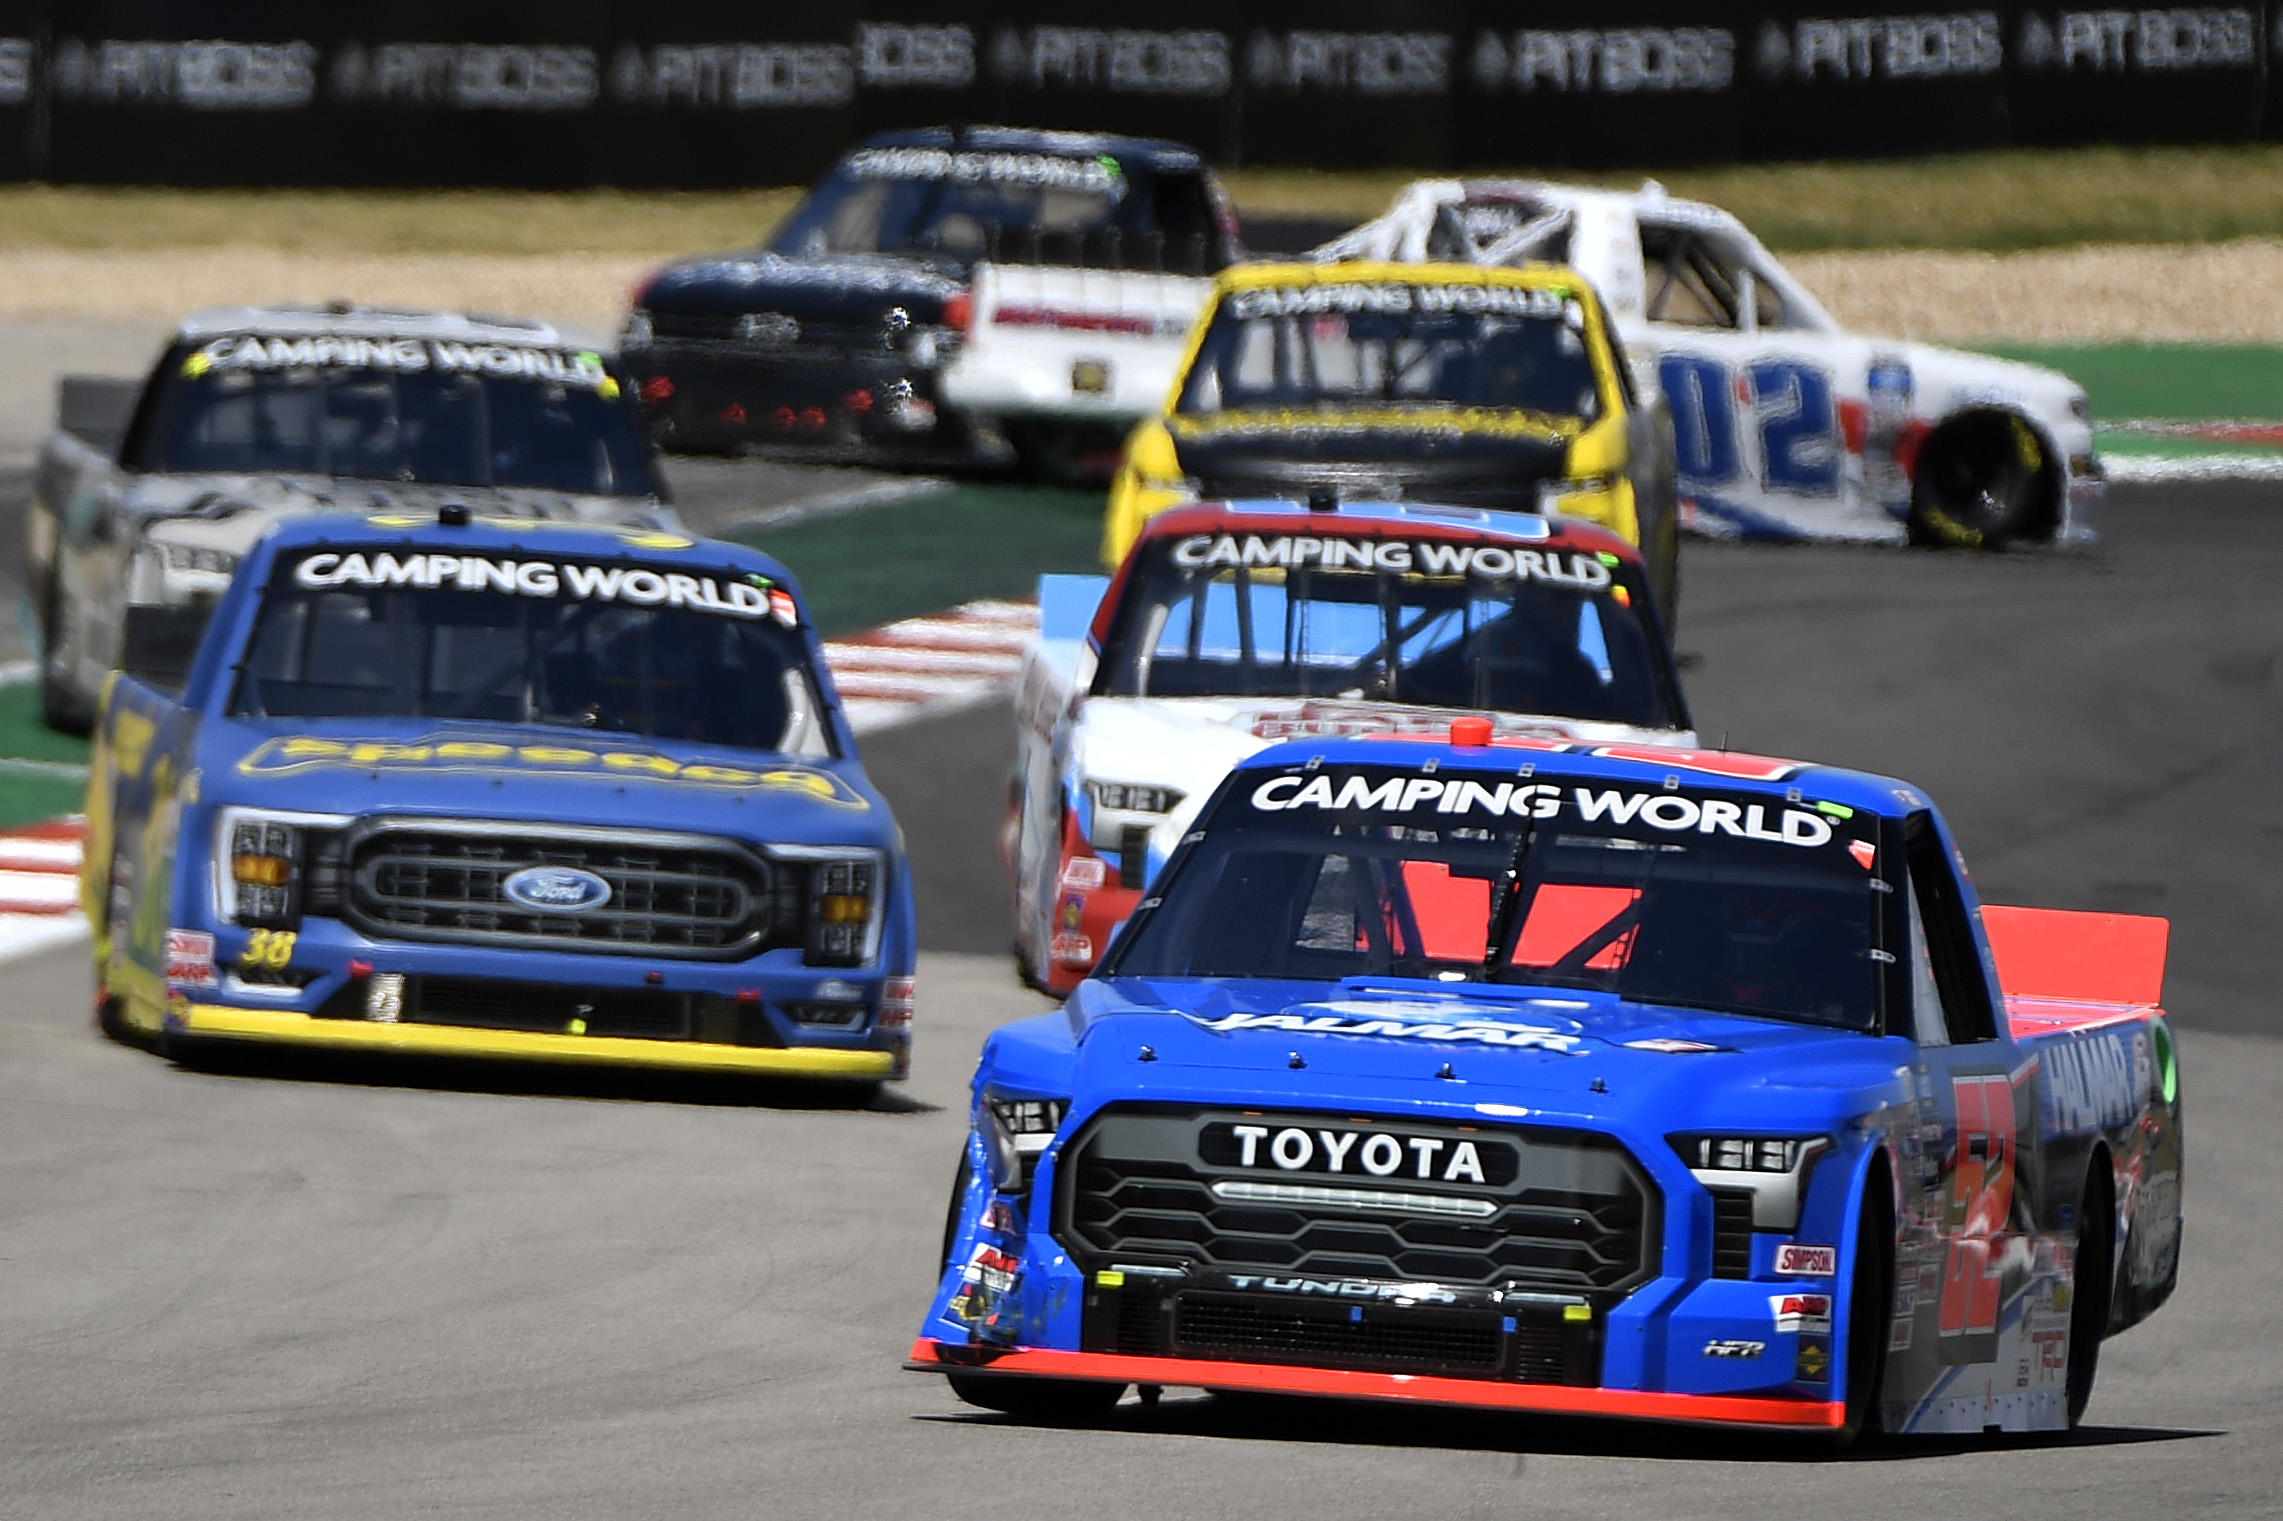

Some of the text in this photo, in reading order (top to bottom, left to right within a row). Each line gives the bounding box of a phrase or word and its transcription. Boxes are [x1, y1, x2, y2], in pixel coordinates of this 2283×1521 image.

[204, 336, 606, 390] CAMPING WORLD
[1658, 347, 1840, 497] 02
[296, 552, 772, 618] CAMPING WORLD
[1174, 536, 1612, 588] CAMPING WORLD
[1251, 775, 1562, 817] CAMPING
[529, 877, 588, 901] Ford
[241, 927, 297, 969] 38
[1232, 1124, 1486, 1184] TOYOTA
[1782, 1248, 1832, 1272] SIMPSON
[1228, 1274, 1456, 1304] TUNDA
